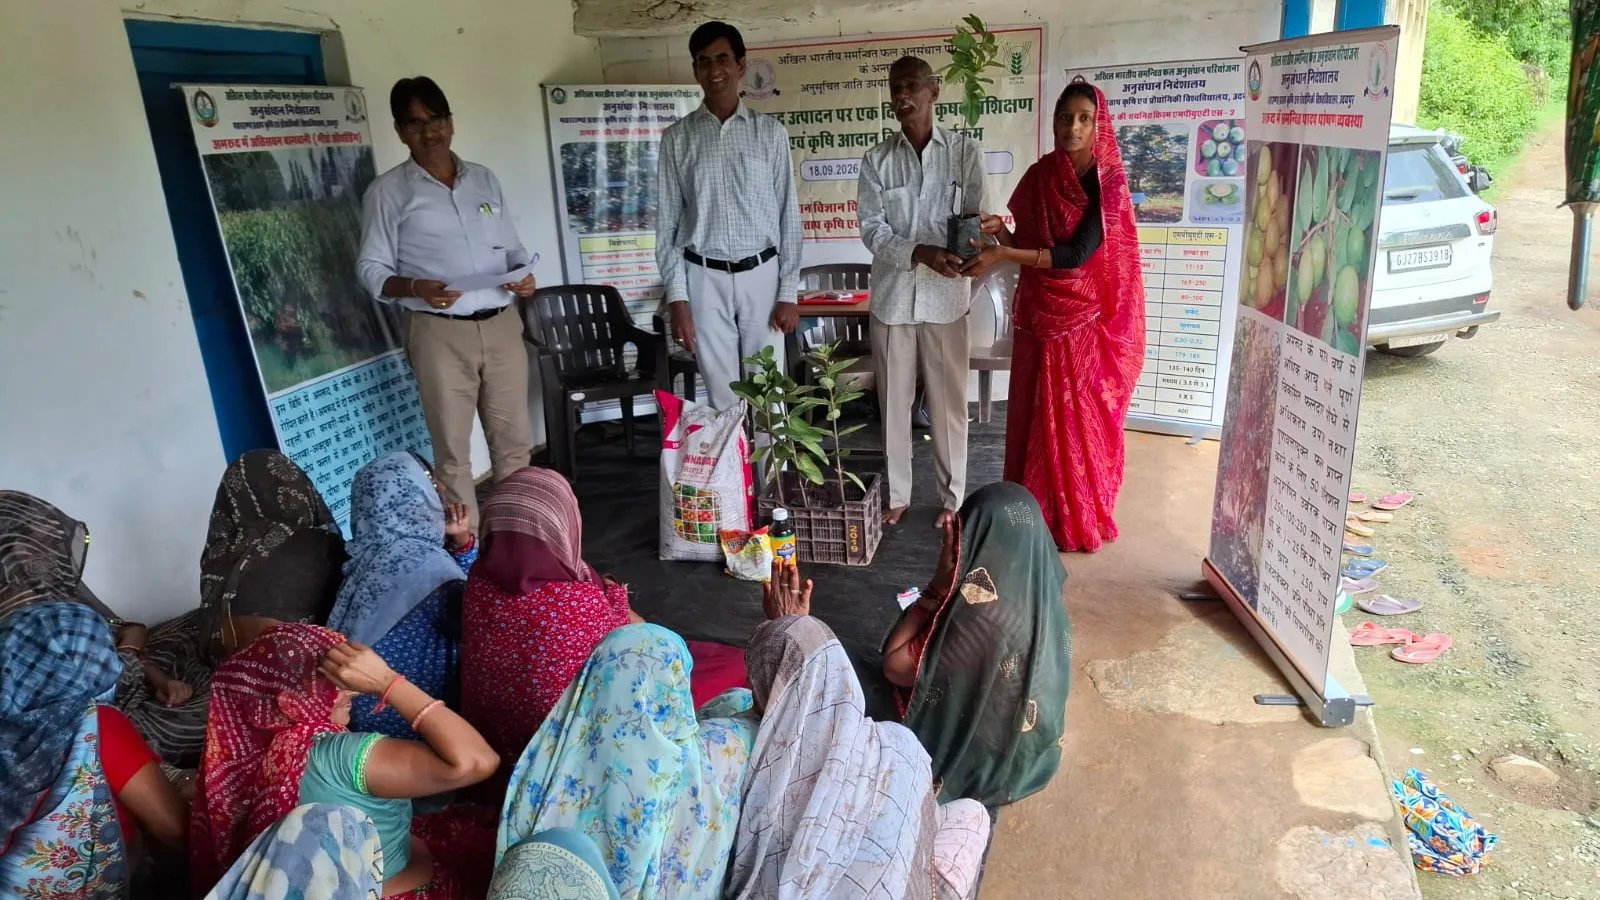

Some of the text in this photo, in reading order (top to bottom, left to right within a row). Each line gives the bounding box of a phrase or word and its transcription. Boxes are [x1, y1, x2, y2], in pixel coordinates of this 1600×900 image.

[778, 53, 806, 64] अखिल
[809, 50, 841, 62] भारतीय
[843, 47, 878, 60] समन्वित
[880, 48, 898, 57] फल
[841, 78, 863, 89] जाति
[1122, 78, 1206, 95] अनुसंधान निदेशालय
[787, 109, 833, 125] उत्पादन
[835, 108, 853, 122] पर
[856, 107, 879, 121] एक
[934, 101, 963, 122] कृष
[979, 95, 1034, 115] शिक्षण
[807, 131, 834, 153] कृषि
[838, 132, 879, 148] आदान
[809, 163, 858, 177] 18.09.2026
[813, 200, 845, 213] विज्ञान
[824, 217, 844, 232] कृषि
[1310, 478, 1320, 492] 50
